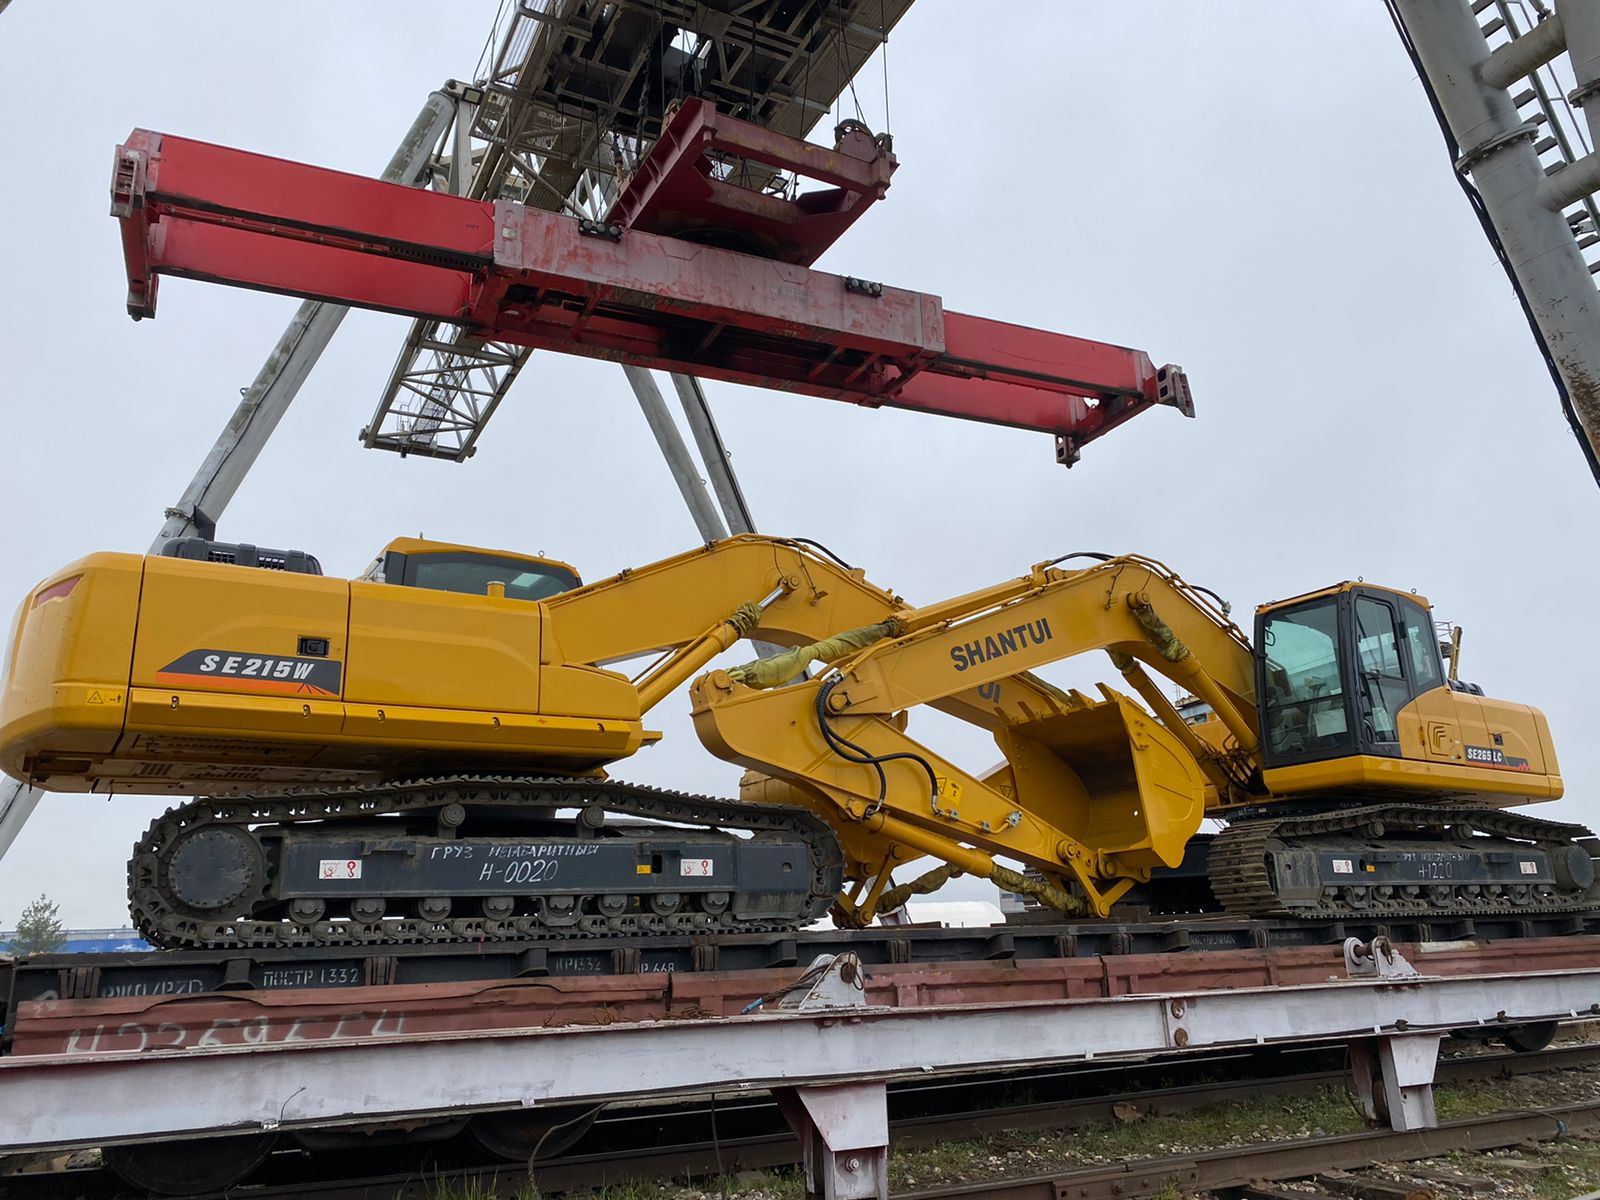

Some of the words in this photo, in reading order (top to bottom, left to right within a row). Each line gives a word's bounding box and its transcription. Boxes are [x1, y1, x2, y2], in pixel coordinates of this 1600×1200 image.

[950, 618, 1053, 672] SHANTUI
[200, 654, 315, 680] SE215W
[430, 846, 473, 860] ГРУЗ
[320, 968, 359, 985] 1332
